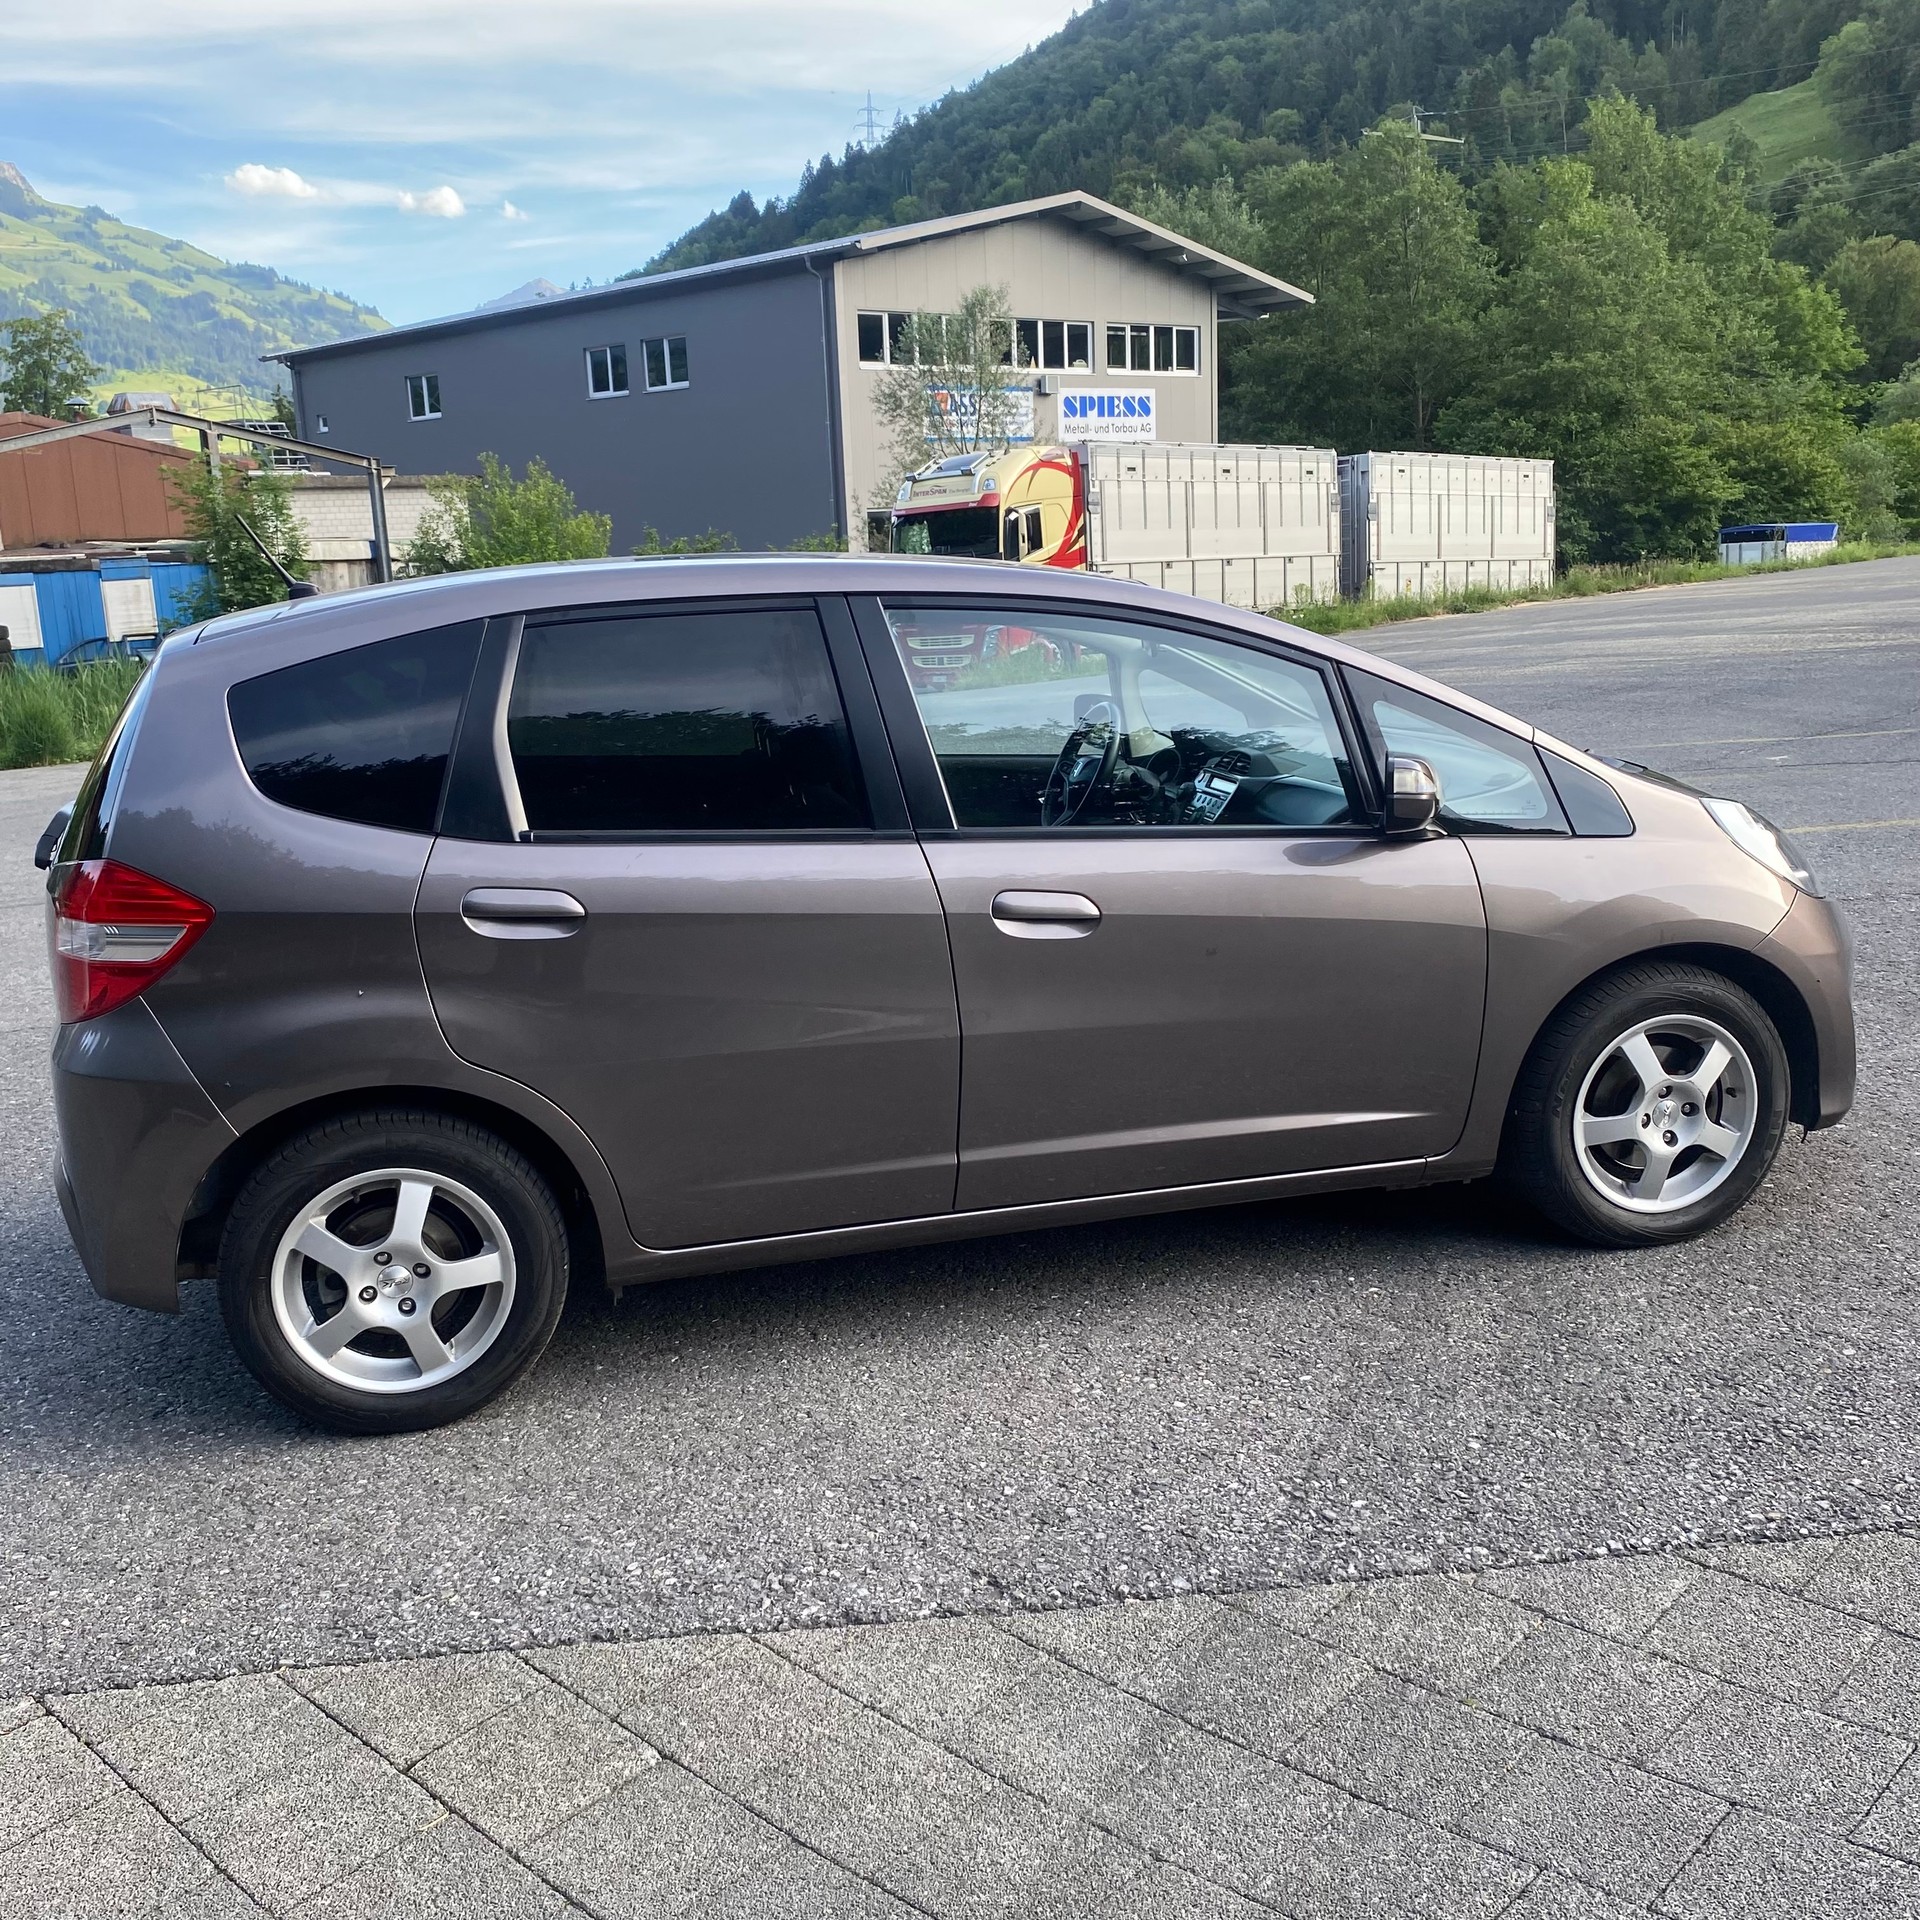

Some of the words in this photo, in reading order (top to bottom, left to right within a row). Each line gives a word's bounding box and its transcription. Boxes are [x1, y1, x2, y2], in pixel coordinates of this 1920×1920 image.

[1063, 396, 1151, 418] SPIESS
[1064, 423, 1092, 434] Metall-
[1094, 423, 1109, 434] und
[1111, 422, 1138, 433] Torbau
[1140, 422, 1151, 433] AG
